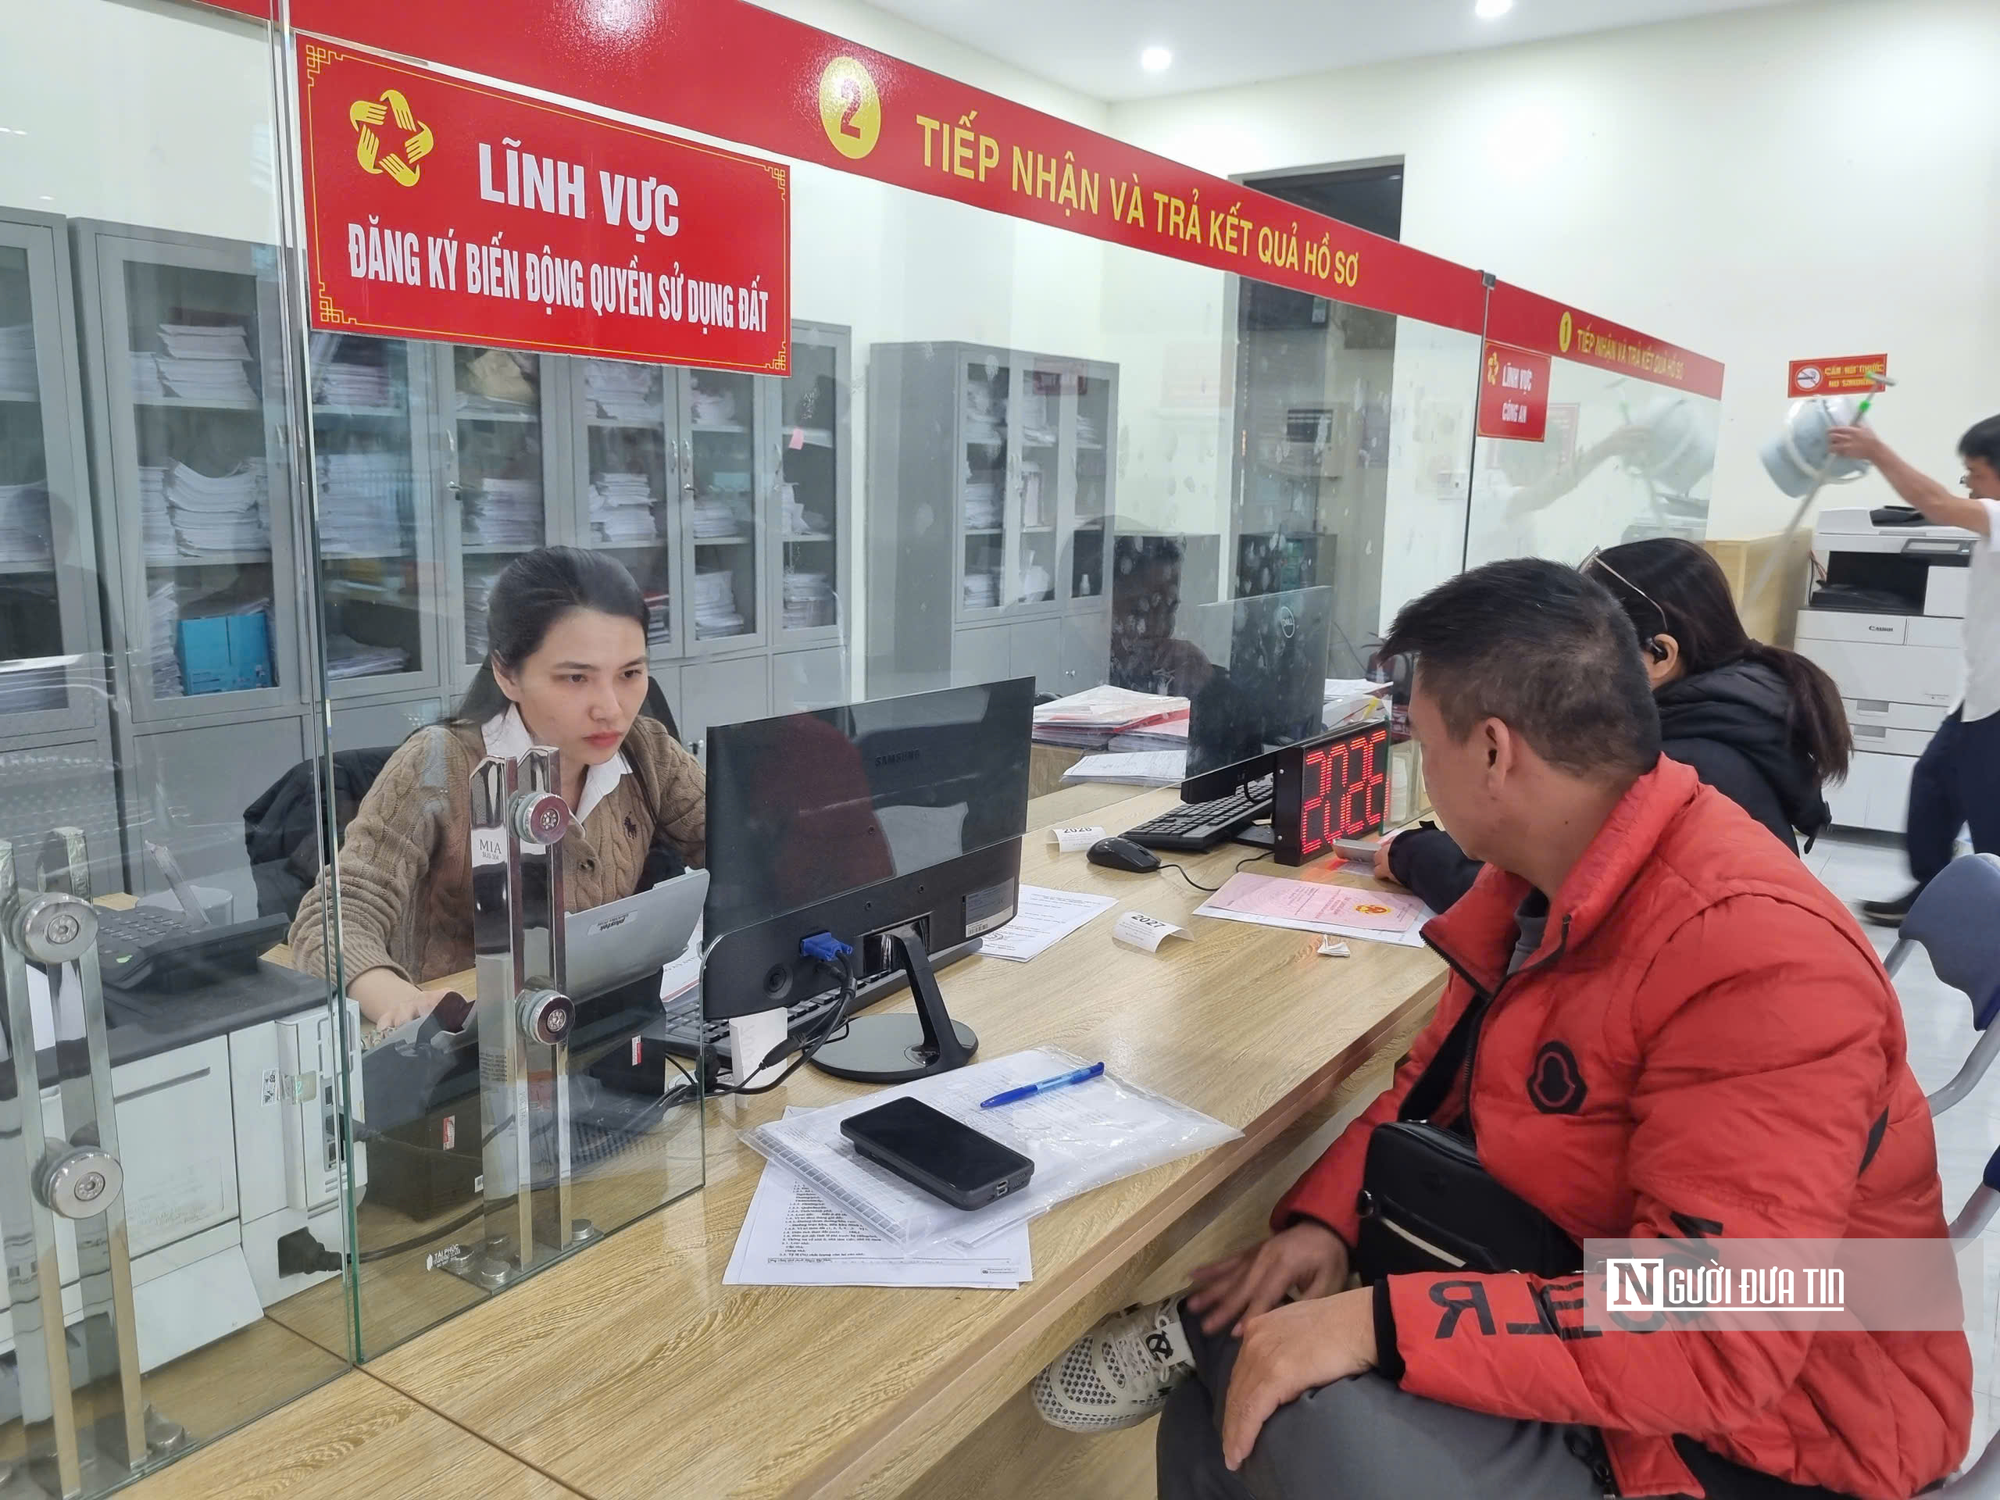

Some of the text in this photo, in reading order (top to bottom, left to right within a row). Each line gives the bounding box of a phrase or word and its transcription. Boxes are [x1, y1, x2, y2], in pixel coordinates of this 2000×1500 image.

[839, 78, 864, 141] 2
[478, 137, 679, 243] LĨNH VỰC
[915, 110, 1360, 287] TIẾP NHẬN VÀ TRẢ KẾT QUẢ HỒ SƠ
[348, 214, 769, 335] ĐĂNG KÝ BIẾN ĐỘNG QUYỀN SỬ DỤNG ĐẤT
[875, 748, 920, 767] SAMSUNG
[480, 839, 502, 854] MIA
[1131, 914, 1166, 928] 2027
